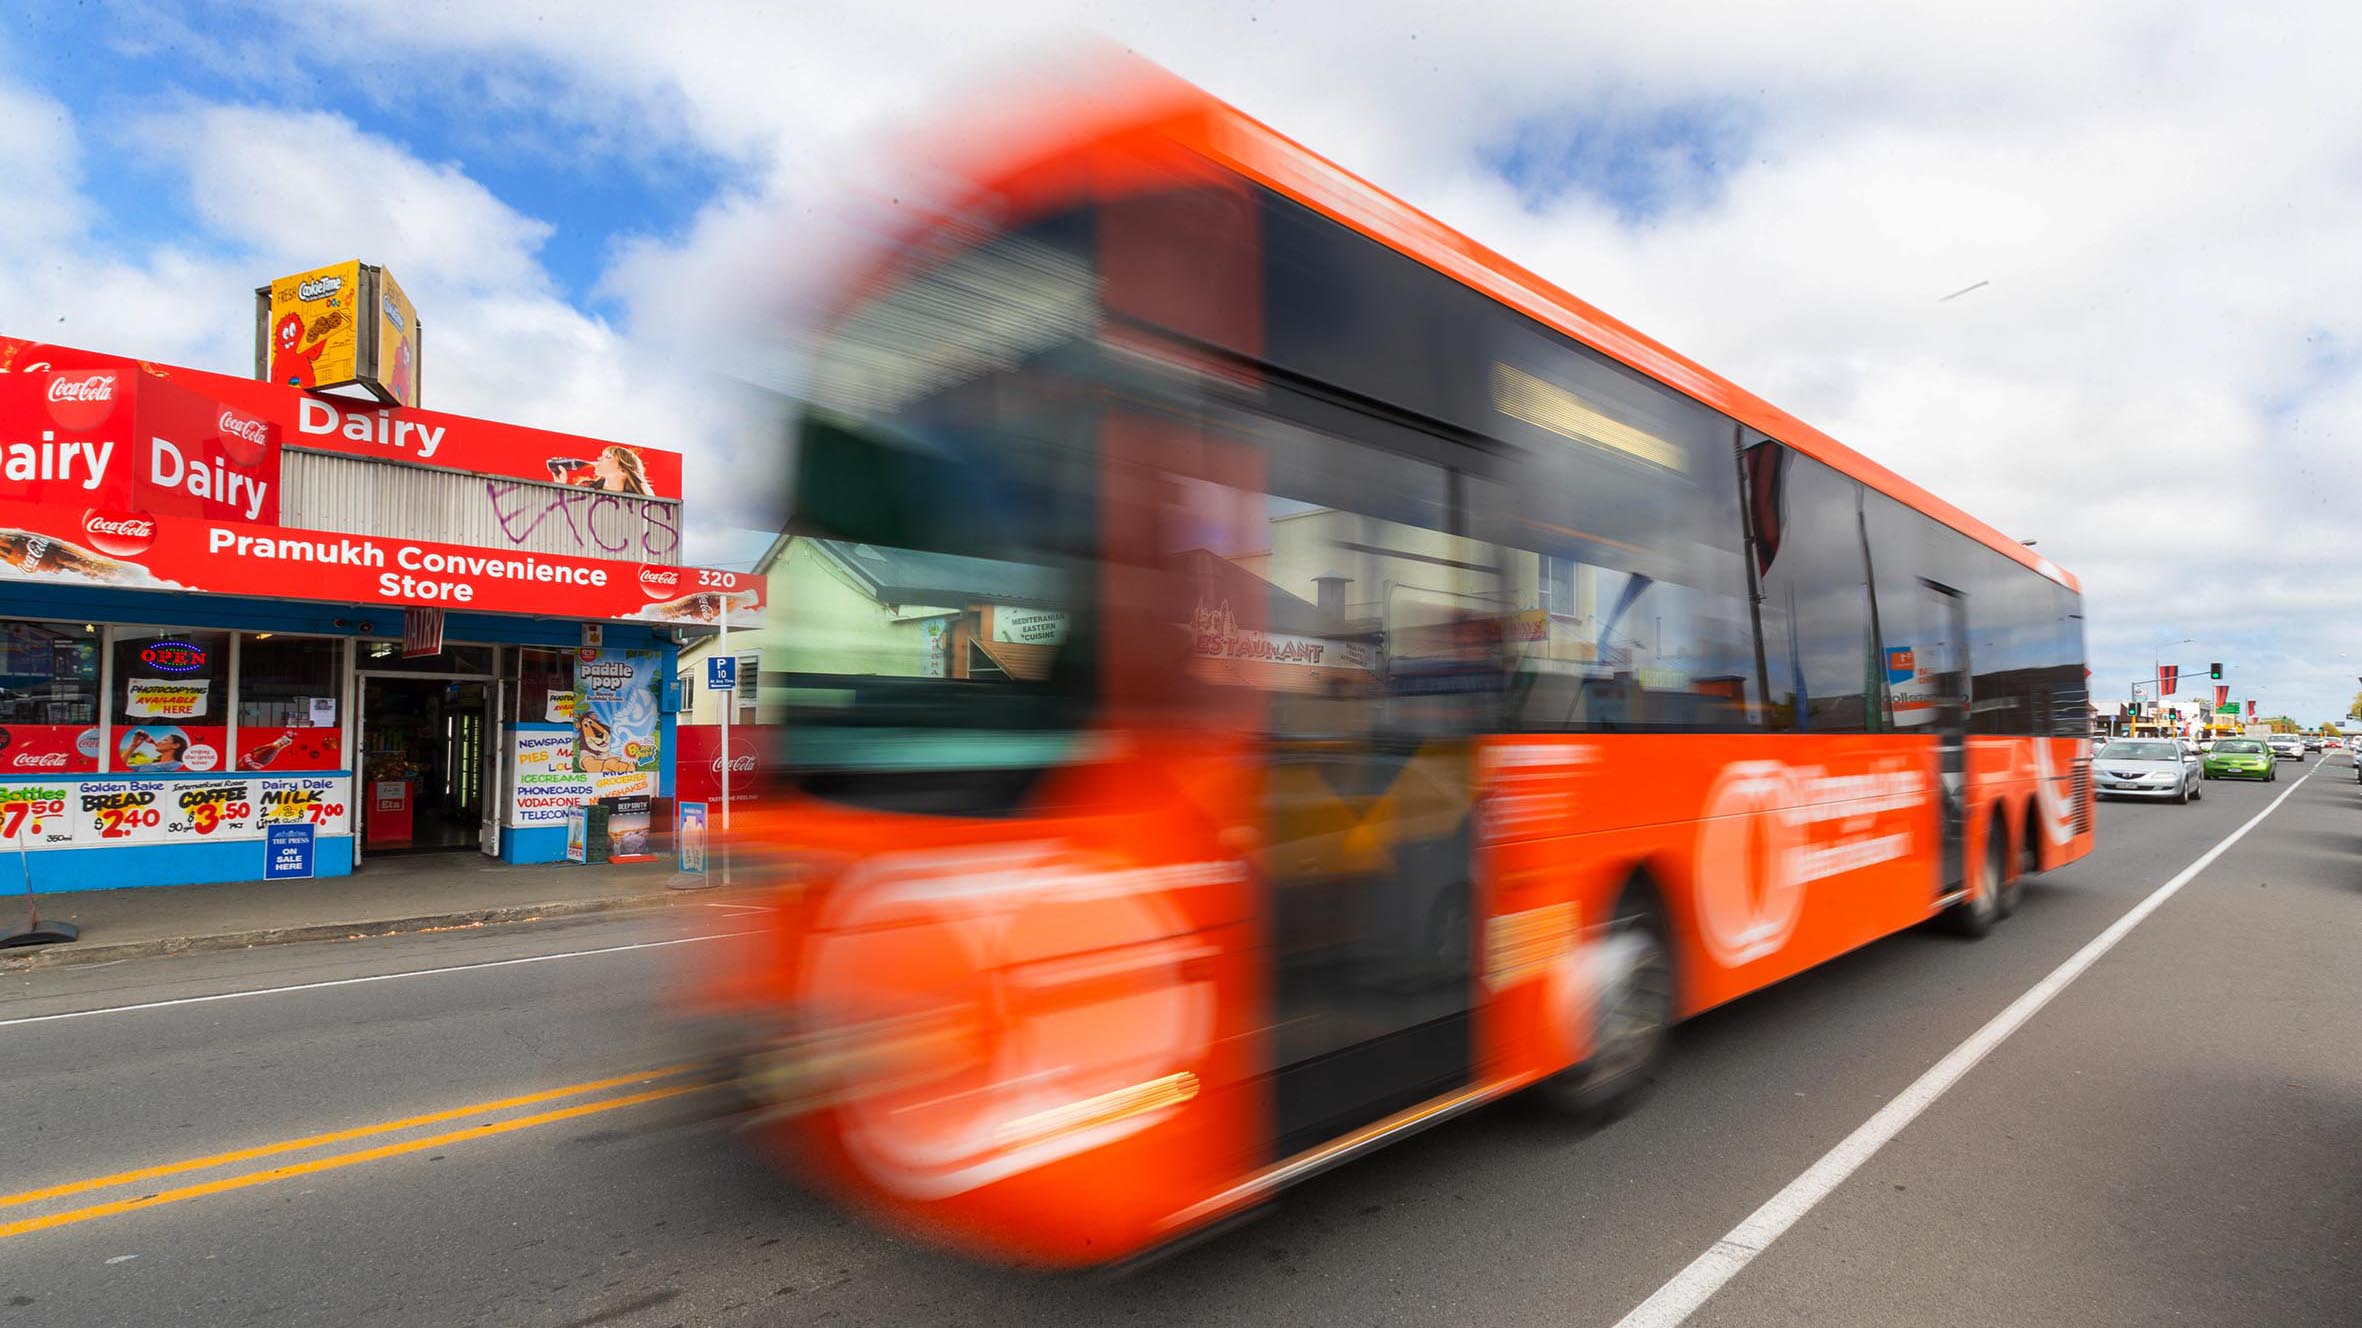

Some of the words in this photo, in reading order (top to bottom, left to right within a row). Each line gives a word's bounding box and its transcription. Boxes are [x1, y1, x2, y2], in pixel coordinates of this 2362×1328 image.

[48, 376, 116, 401] Coca-Cola
[219, 411, 268, 447] Coca-Cola
[300, 397, 447, 459] Dairy
[0, 431, 114, 490] airy
[152, 437, 268, 520] Dairy
[86, 517, 154, 537] Coca-Cola
[209, 528, 385, 567] Pramukh
[397, 546, 608, 587] Convenience
[640, 570, 679, 585] Coca-Cola
[698, 570, 736, 588] 320
[378, 573, 474, 602] Store
[403, 607, 443, 652] DAIRY
[1023, 622, 1056, 633] EASTERN
[1024, 631, 1056, 641] CUISINE
[1195, 634, 1325, 664] ESTAURANT
[140, 649, 207, 665] OPEN
[716, 658, 727, 670] P
[581, 663, 634, 679] paddle
[717, 669, 727, 679] 10
[130, 685, 208, 694] PHOTOCOPYING
[592, 677, 622, 690] pop
[135, 696, 197, 704] AVAILABLE
[163, 705, 193, 715] HERE
[519, 737, 573, 749] NEWSPAP
[13, 753, 70, 767] Coca-Cola
[518, 750, 549, 764] PIES
[80, 782, 126, 793] Golden
[130, 781, 164, 791] Bake
[262, 780, 298, 792] Dairy
[302, 780, 334, 789] Dale
[596, 772, 648, 788] GROCERIES
[178, 786, 248, 809] COFFEE
[260, 790, 325, 805] MILK
[517, 785, 593, 796] PHONECARDS
[80, 792, 155, 812] BREAD
[517, 796, 581, 808] VODAFONE
[260, 806, 270, 818] 2
[276, 855, 303, 863] SALE
[275, 863, 303, 871] HERE
